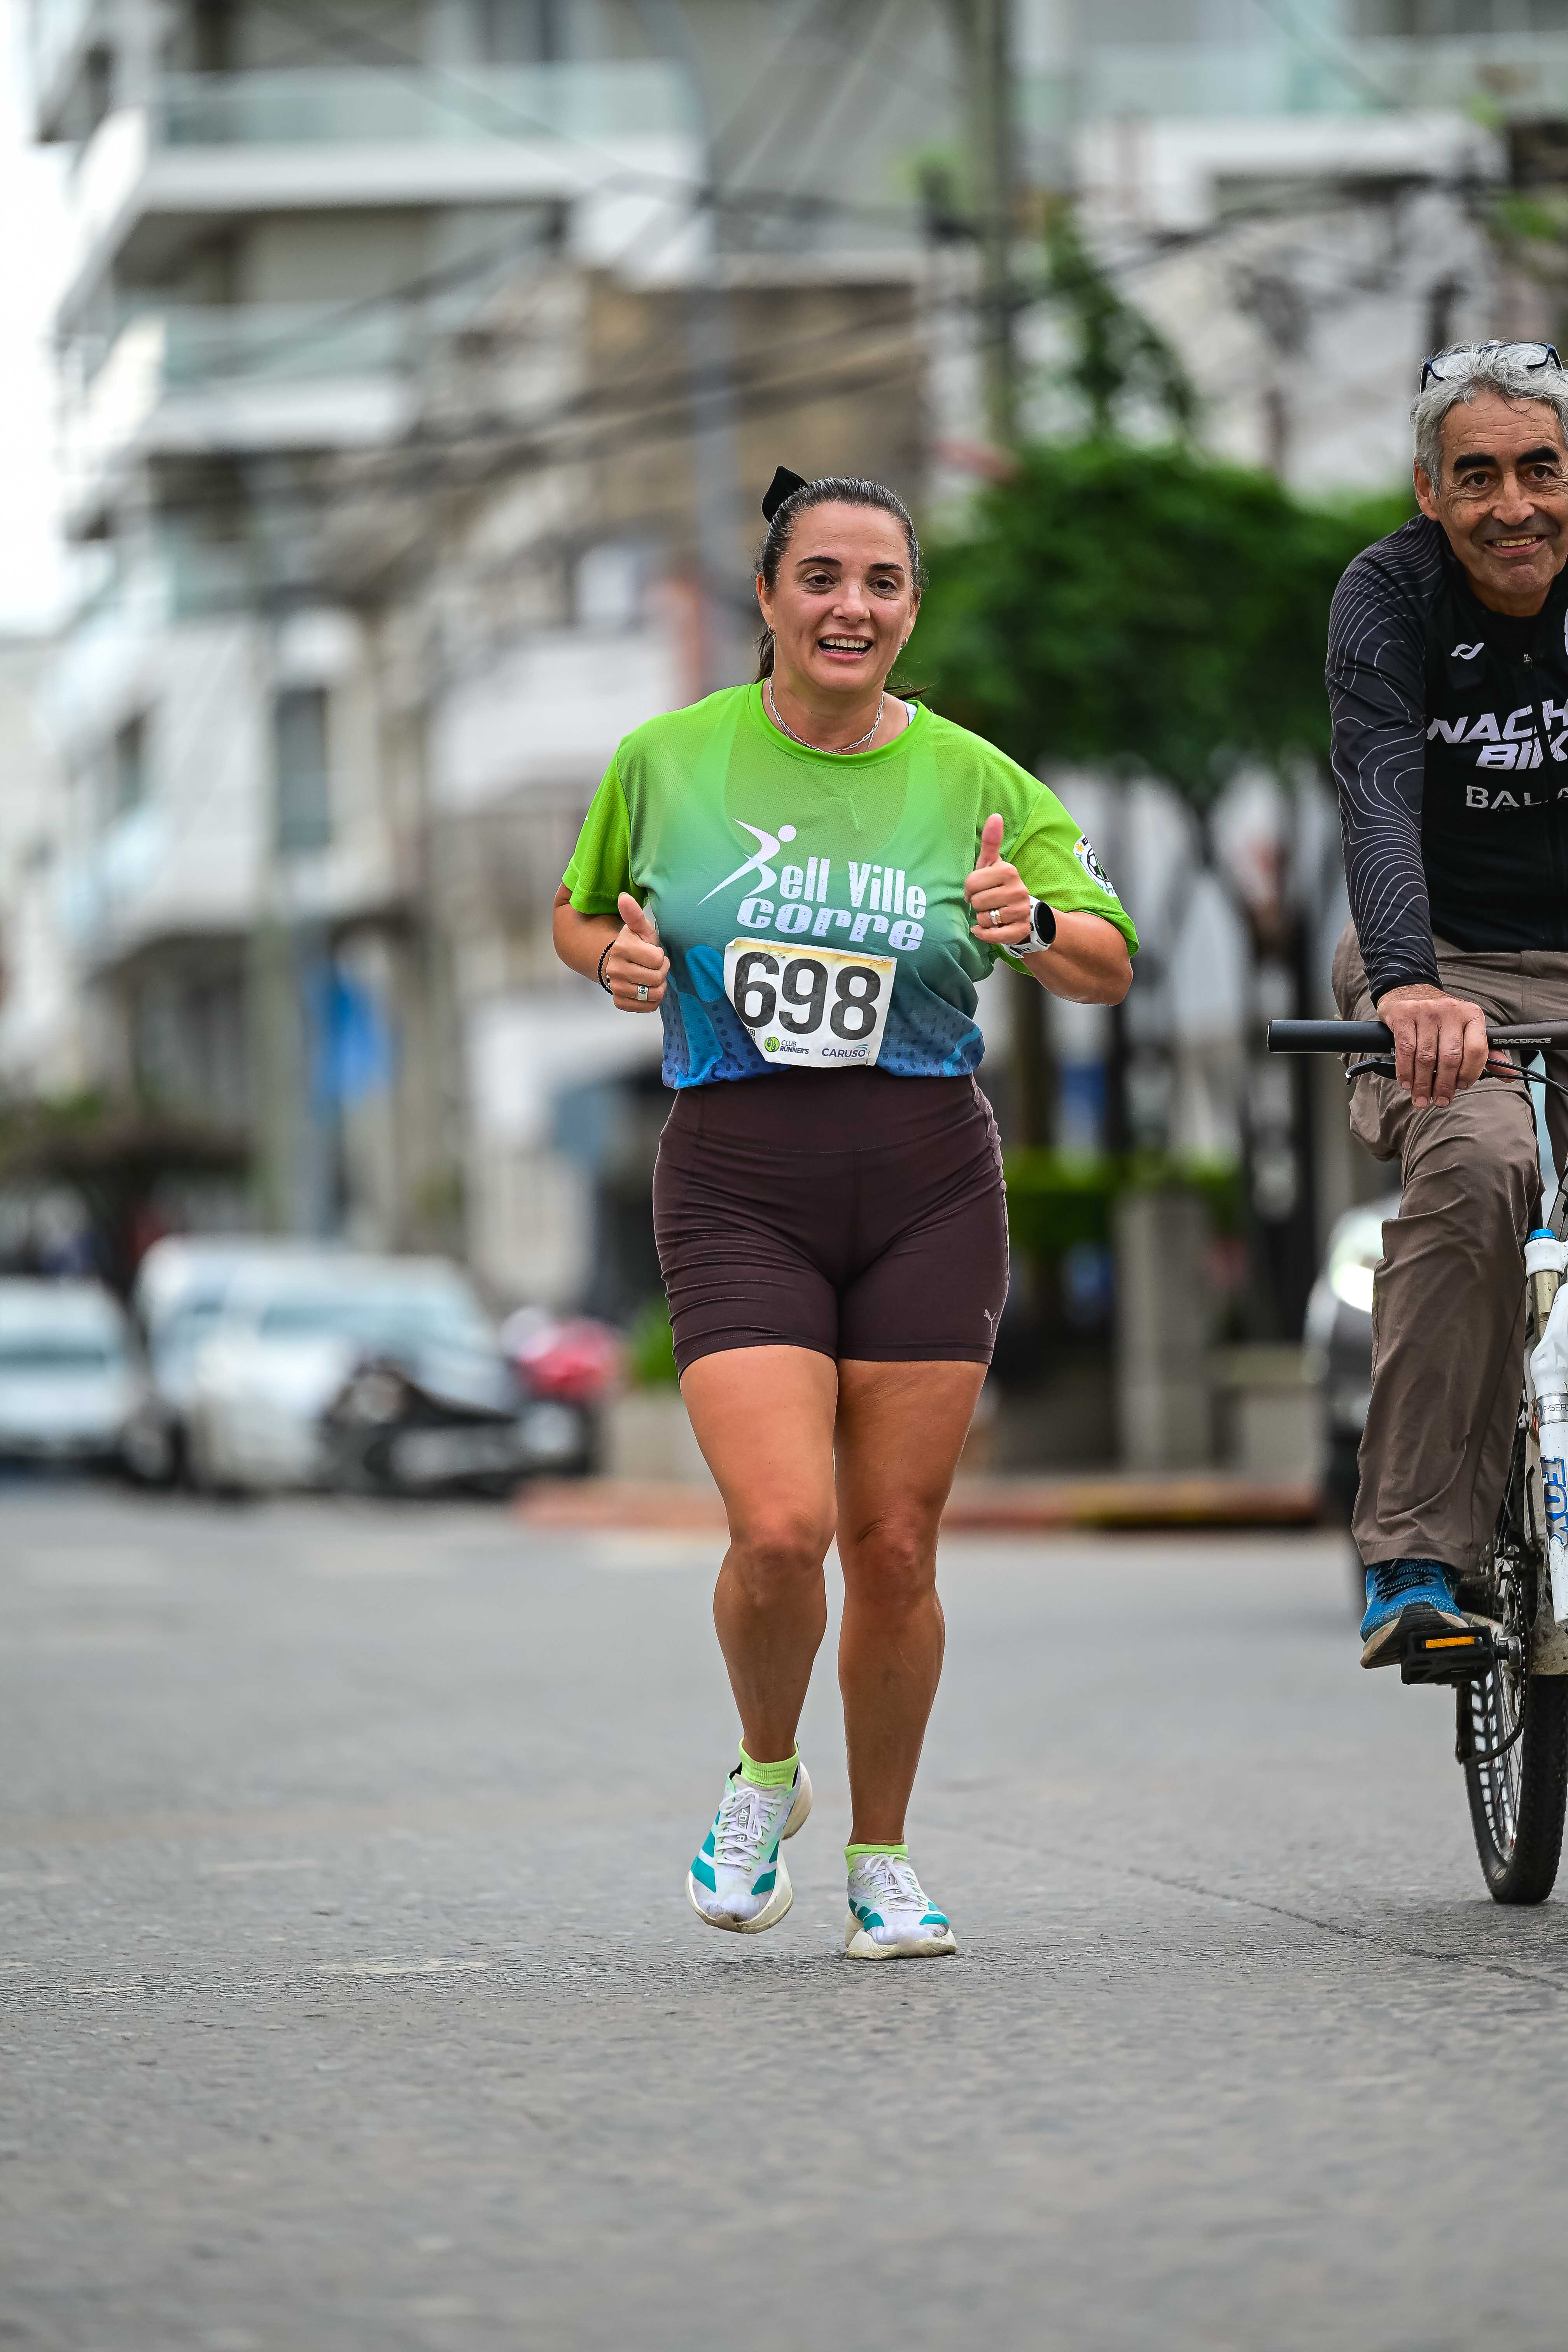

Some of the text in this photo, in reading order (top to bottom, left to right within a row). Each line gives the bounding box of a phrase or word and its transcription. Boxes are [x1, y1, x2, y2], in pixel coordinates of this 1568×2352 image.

[848, 861, 927, 919] Ville
[733, 951, 881, 1040] 698
[779, 1046, 810, 1054] RUNNER'S
[821, 1048, 866, 1058] CARUSO
[1540, 1457, 1568, 1547] FOX
